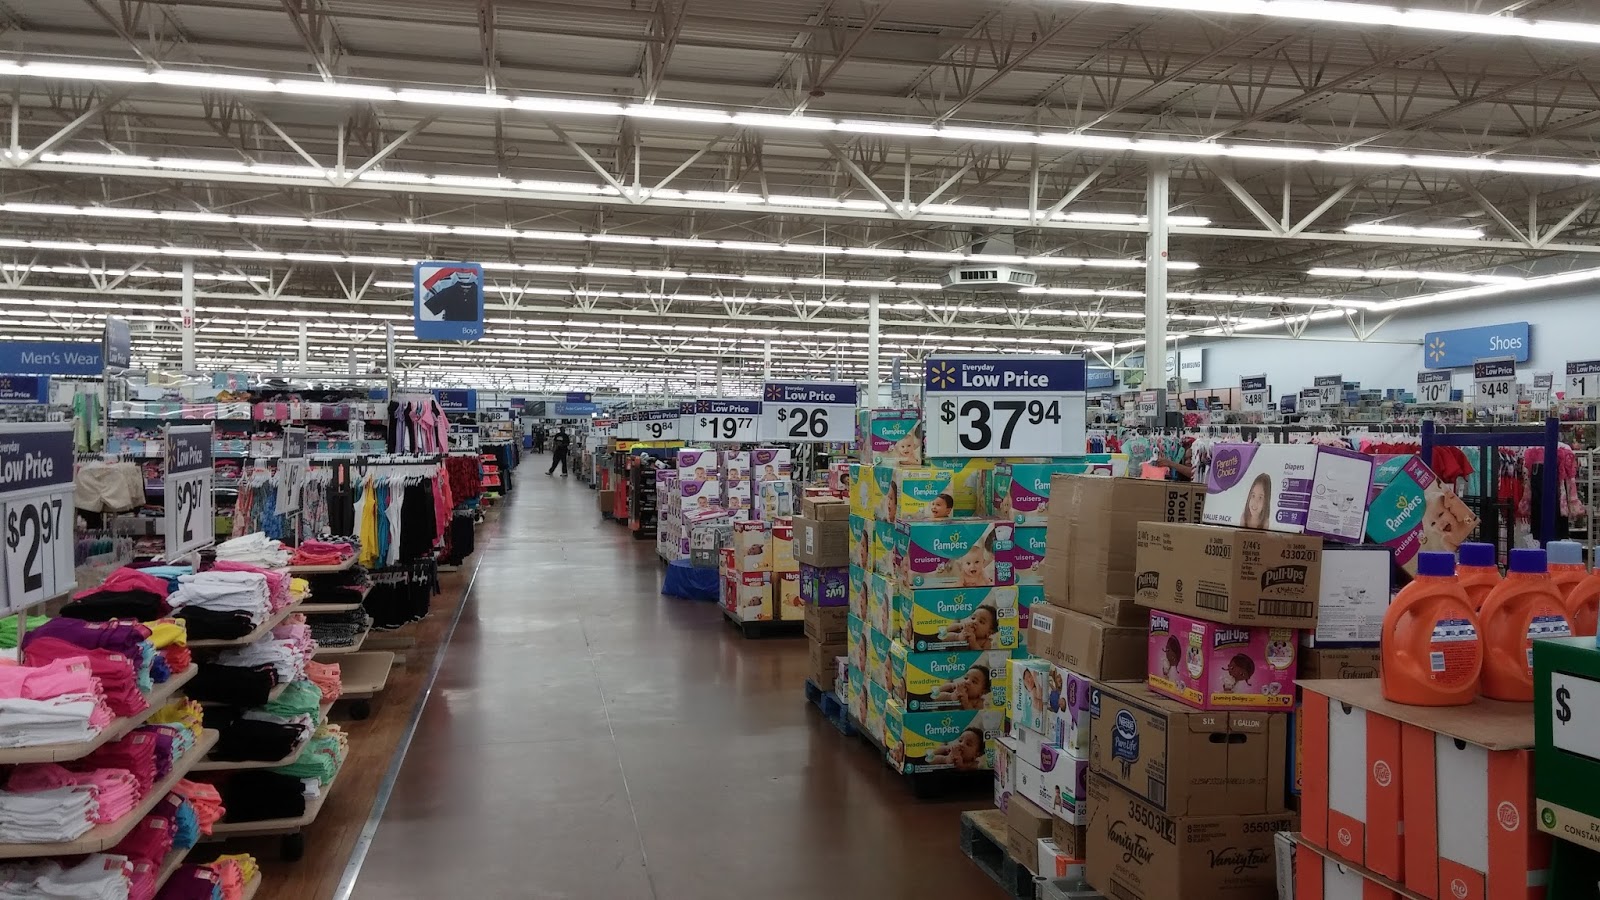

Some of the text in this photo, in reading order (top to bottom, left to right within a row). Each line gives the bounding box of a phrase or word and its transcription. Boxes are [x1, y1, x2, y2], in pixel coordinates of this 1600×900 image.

[462, 327, 478, 336] Boys
[1489, 335, 1522, 351] Shoes
[21, 351, 99, 366] Men's Wear
[962, 363, 995, 373] Everyday
[1181, 361, 1201, 369] SAMSUNG
[1577, 365, 1587, 373] Low
[1485, 366, 1513, 376] Low Price
[962, 370, 1050, 388] Low Price
[14, 391, 30, 399] Price
[784, 390, 836, 401] Low Price
[711, 405, 750, 413] Low Price
[649, 411, 678, 420] Low Price
[777, 407, 829, 438] $26
[881, 425, 906, 436] Pampers
[177, 445, 203, 467] Low Price
[25, 449, 54, 481] Price
[1216, 456, 1238, 470] Parent's
[1284, 463, 1305, 471] Diapers
[1217, 467, 1237, 479] Choice
[913, 486, 938, 497] Pampers
[1203, 512, 1232, 522] VALUE PACK
[1277, 511, 1283, 520] 6
[1385, 494, 1423, 532] Pampers
[933, 538, 968, 551] Pampers
[995, 541, 1001, 550] 6
[1394, 530, 1418, 557] cruisers
[914, 556, 941, 564] cruisers
[1265, 567, 1304, 586] Pull-Ups
[825, 582, 846, 599] Luvs
[937, 600, 973, 613] Pampers
[997, 608, 1005, 618] 6
[1151, 615, 1169, 632] Pull-Ups
[1215, 629, 1249, 646] Pull-Ups
[919, 641, 925, 649] 3
[930, 660, 966, 674] Pampers
[990, 668, 997, 679] 6
[1092, 690, 1099, 705] 6
[1555, 684, 1571, 726] $
[1202, 717, 1215, 725] SIX
[1237, 719, 1260, 727] GALLON
[924, 722, 960, 736] Pampers
[984, 731, 991, 740] 6
[1374, 766, 1390, 780] Tide
[1499, 809, 1518, 824] Tide
[1187, 824, 1192, 833] 8
[1187, 834, 1192, 843] 8
[1453, 883, 1465, 895] he
